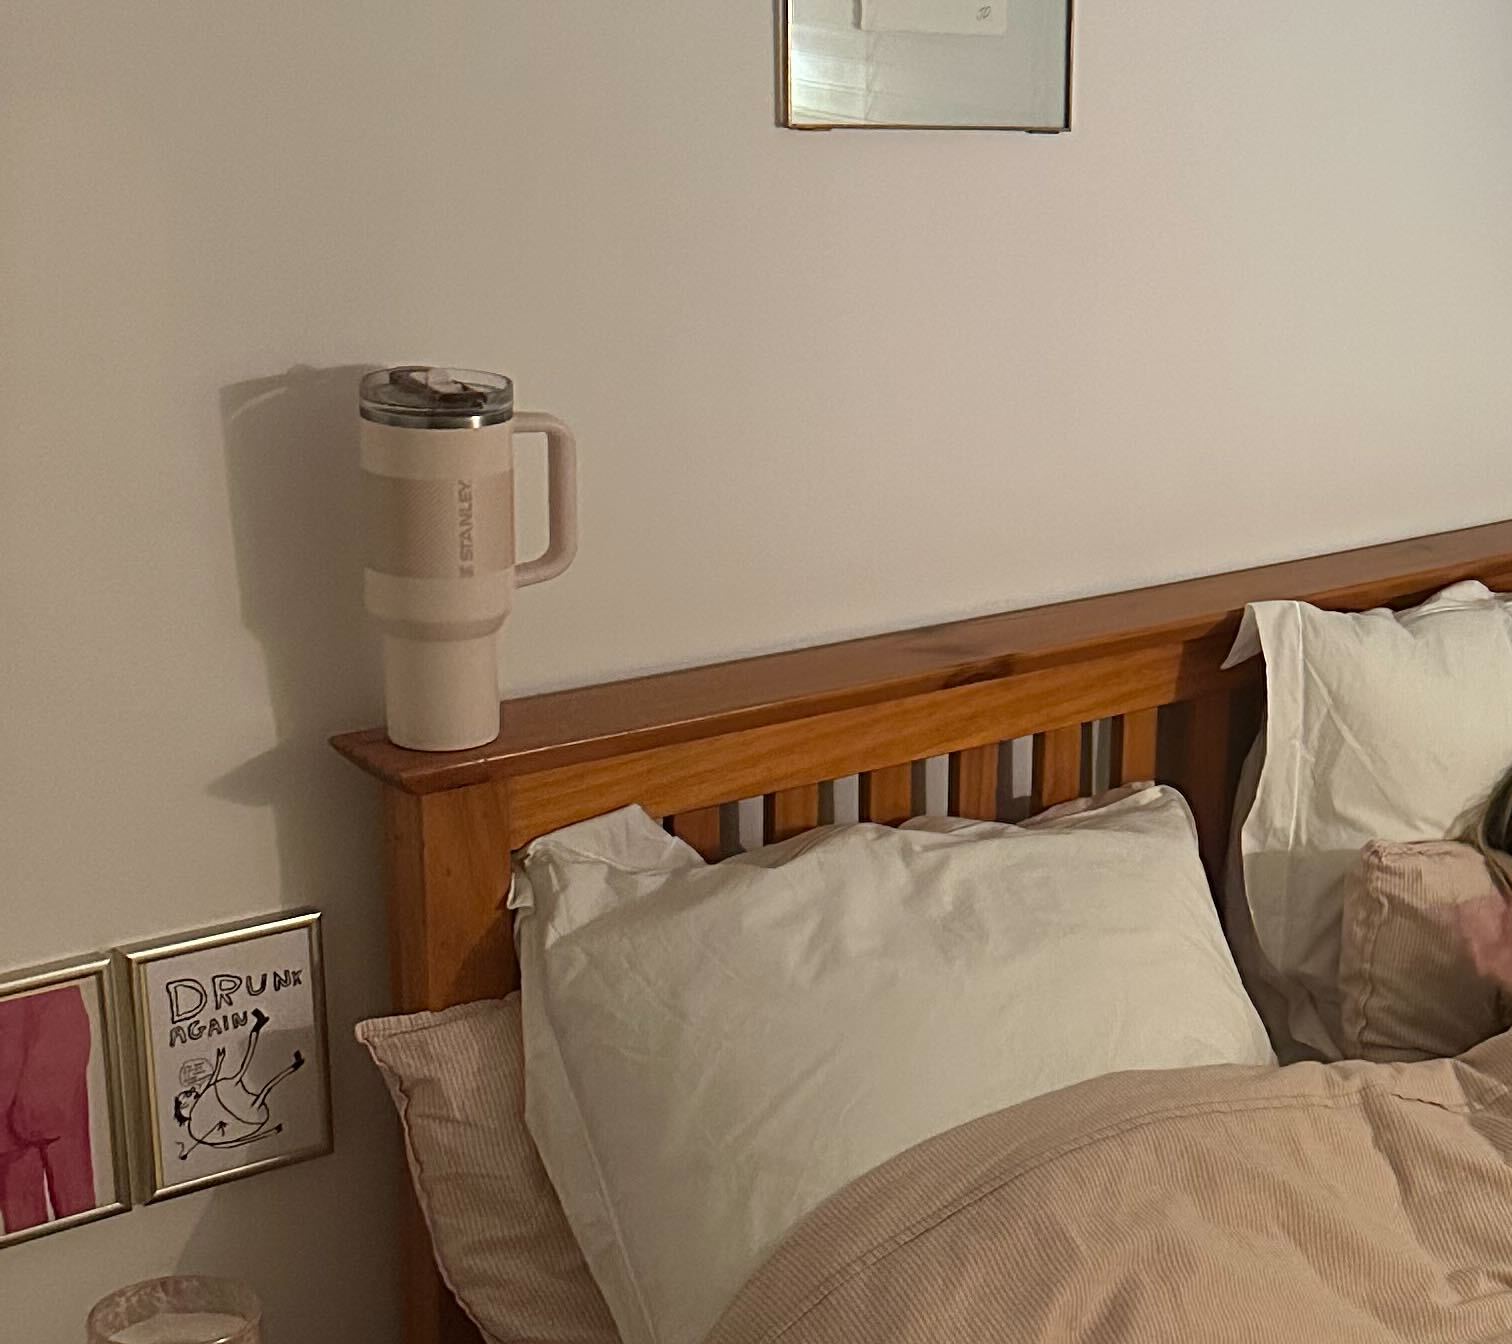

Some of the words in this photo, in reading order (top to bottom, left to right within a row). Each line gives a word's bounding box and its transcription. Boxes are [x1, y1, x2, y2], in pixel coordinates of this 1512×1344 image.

[458, 480, 473, 561] STANLEY
[165, 969, 303, 1024] DRUNK
[168, 1009, 248, 1047] AGAIN
